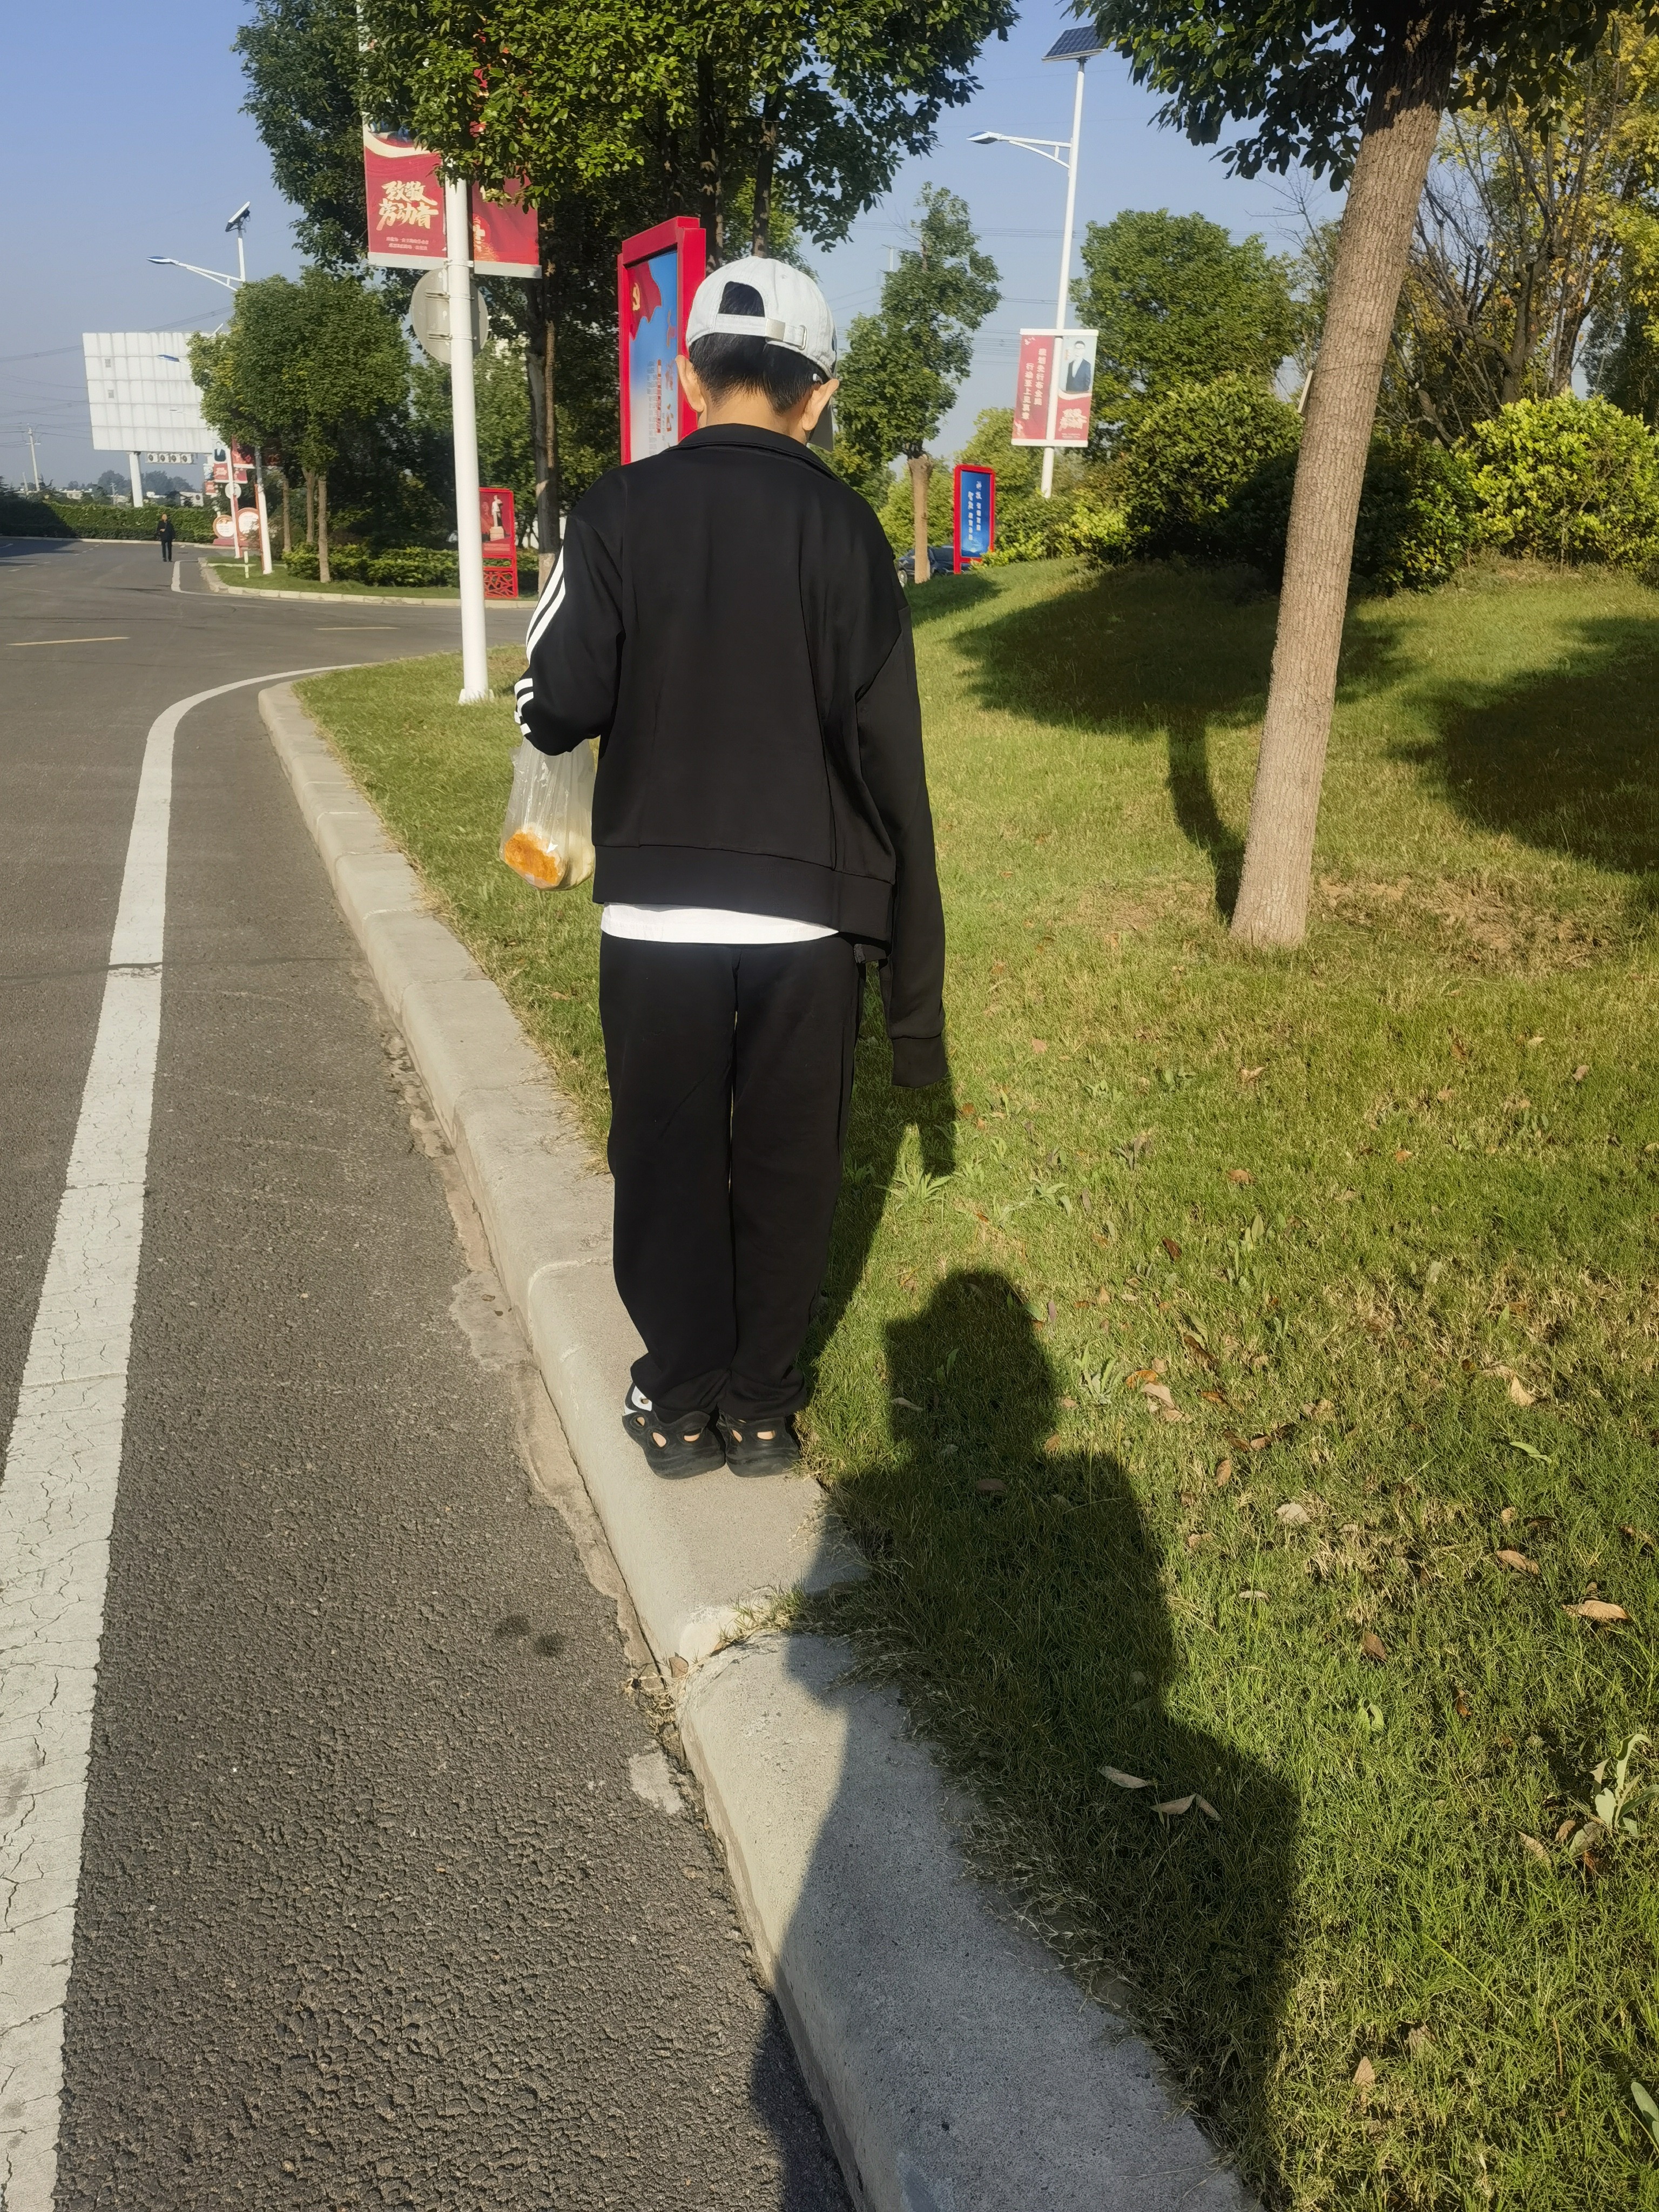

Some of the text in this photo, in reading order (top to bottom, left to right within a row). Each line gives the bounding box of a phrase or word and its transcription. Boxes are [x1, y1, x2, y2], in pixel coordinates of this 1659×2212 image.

[381, 180, 437, 205] 致敬
[376, 198, 439, 231] 劳动者
